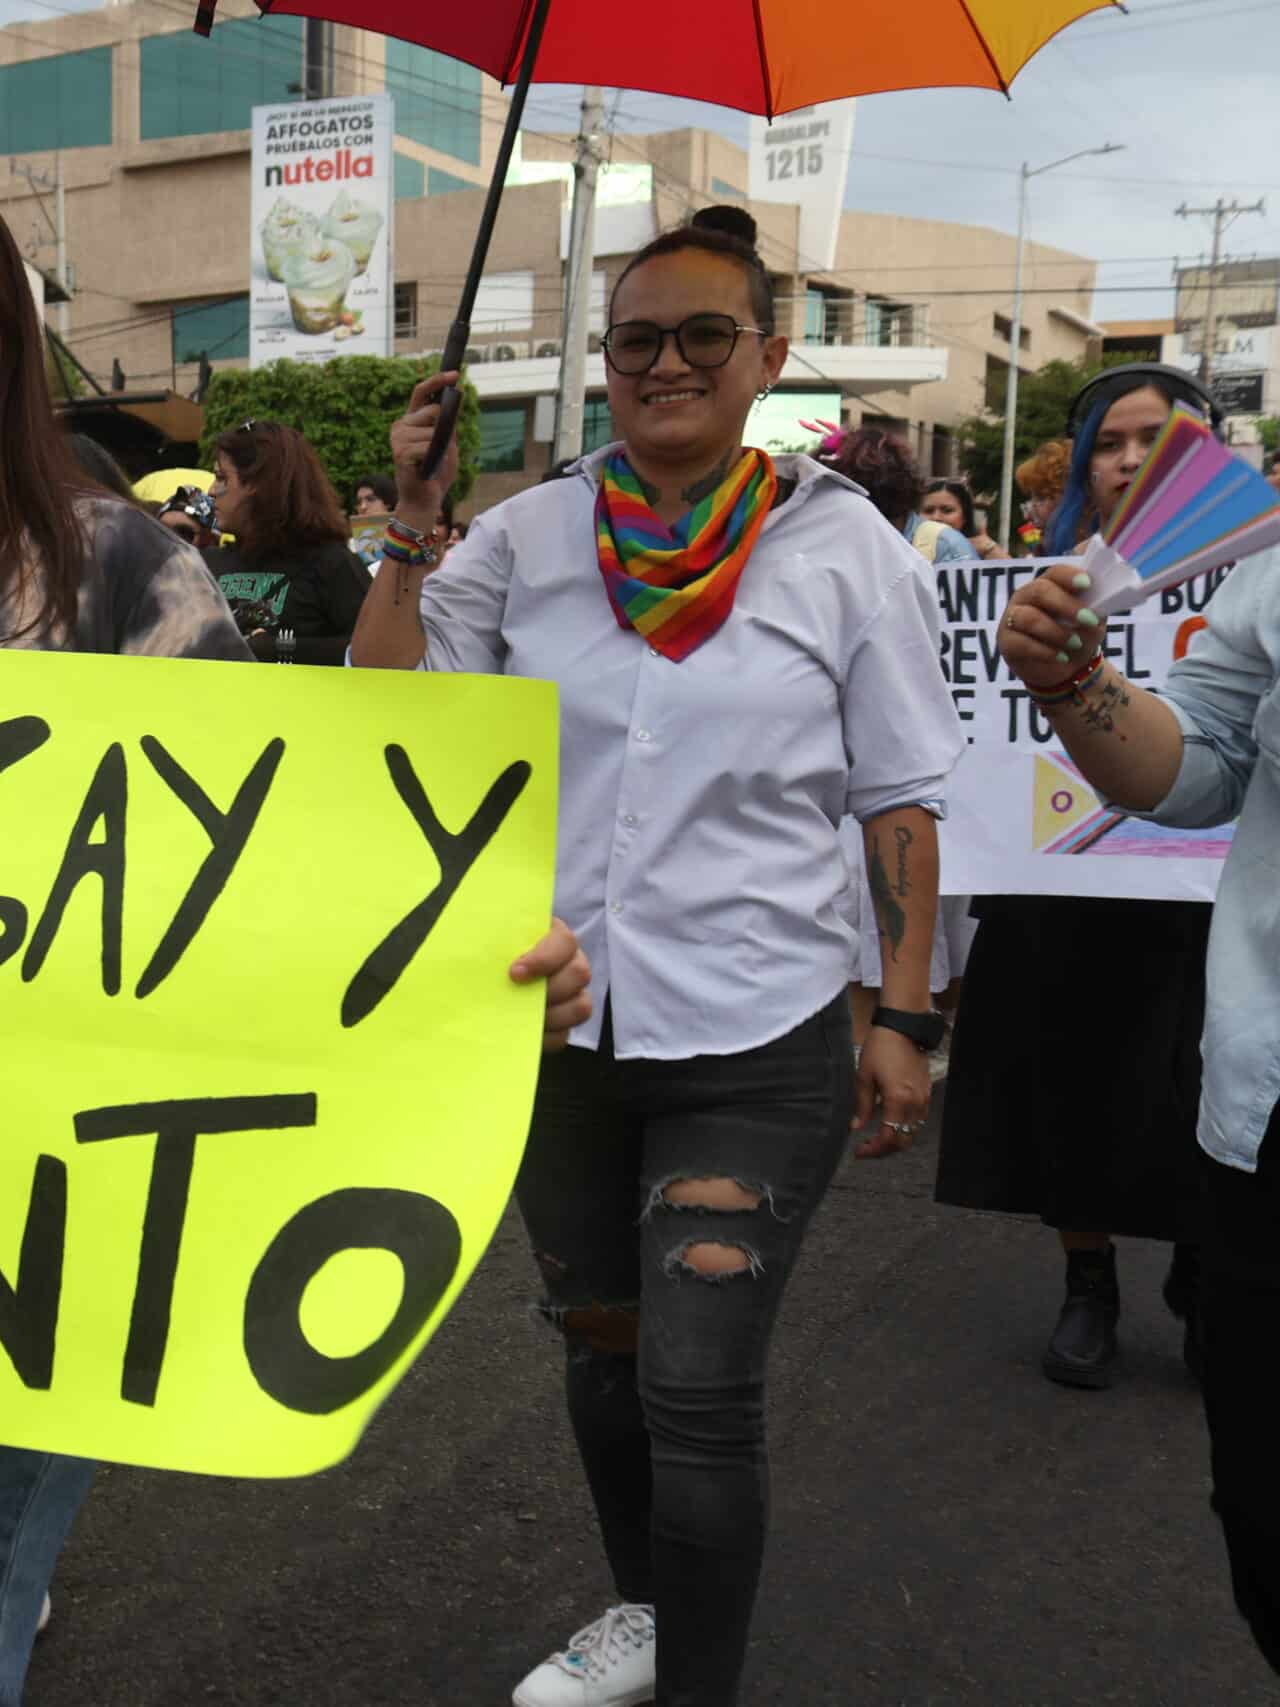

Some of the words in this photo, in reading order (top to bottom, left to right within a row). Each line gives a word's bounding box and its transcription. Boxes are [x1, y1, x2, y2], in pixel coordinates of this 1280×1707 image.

[267, 114, 374, 140] AFFOGATOS
[343, 134, 374, 148] CON
[265, 150, 373, 187] nutella
[765, 143, 824, 182] 1215
[340, 742, 532, 1028] Y
